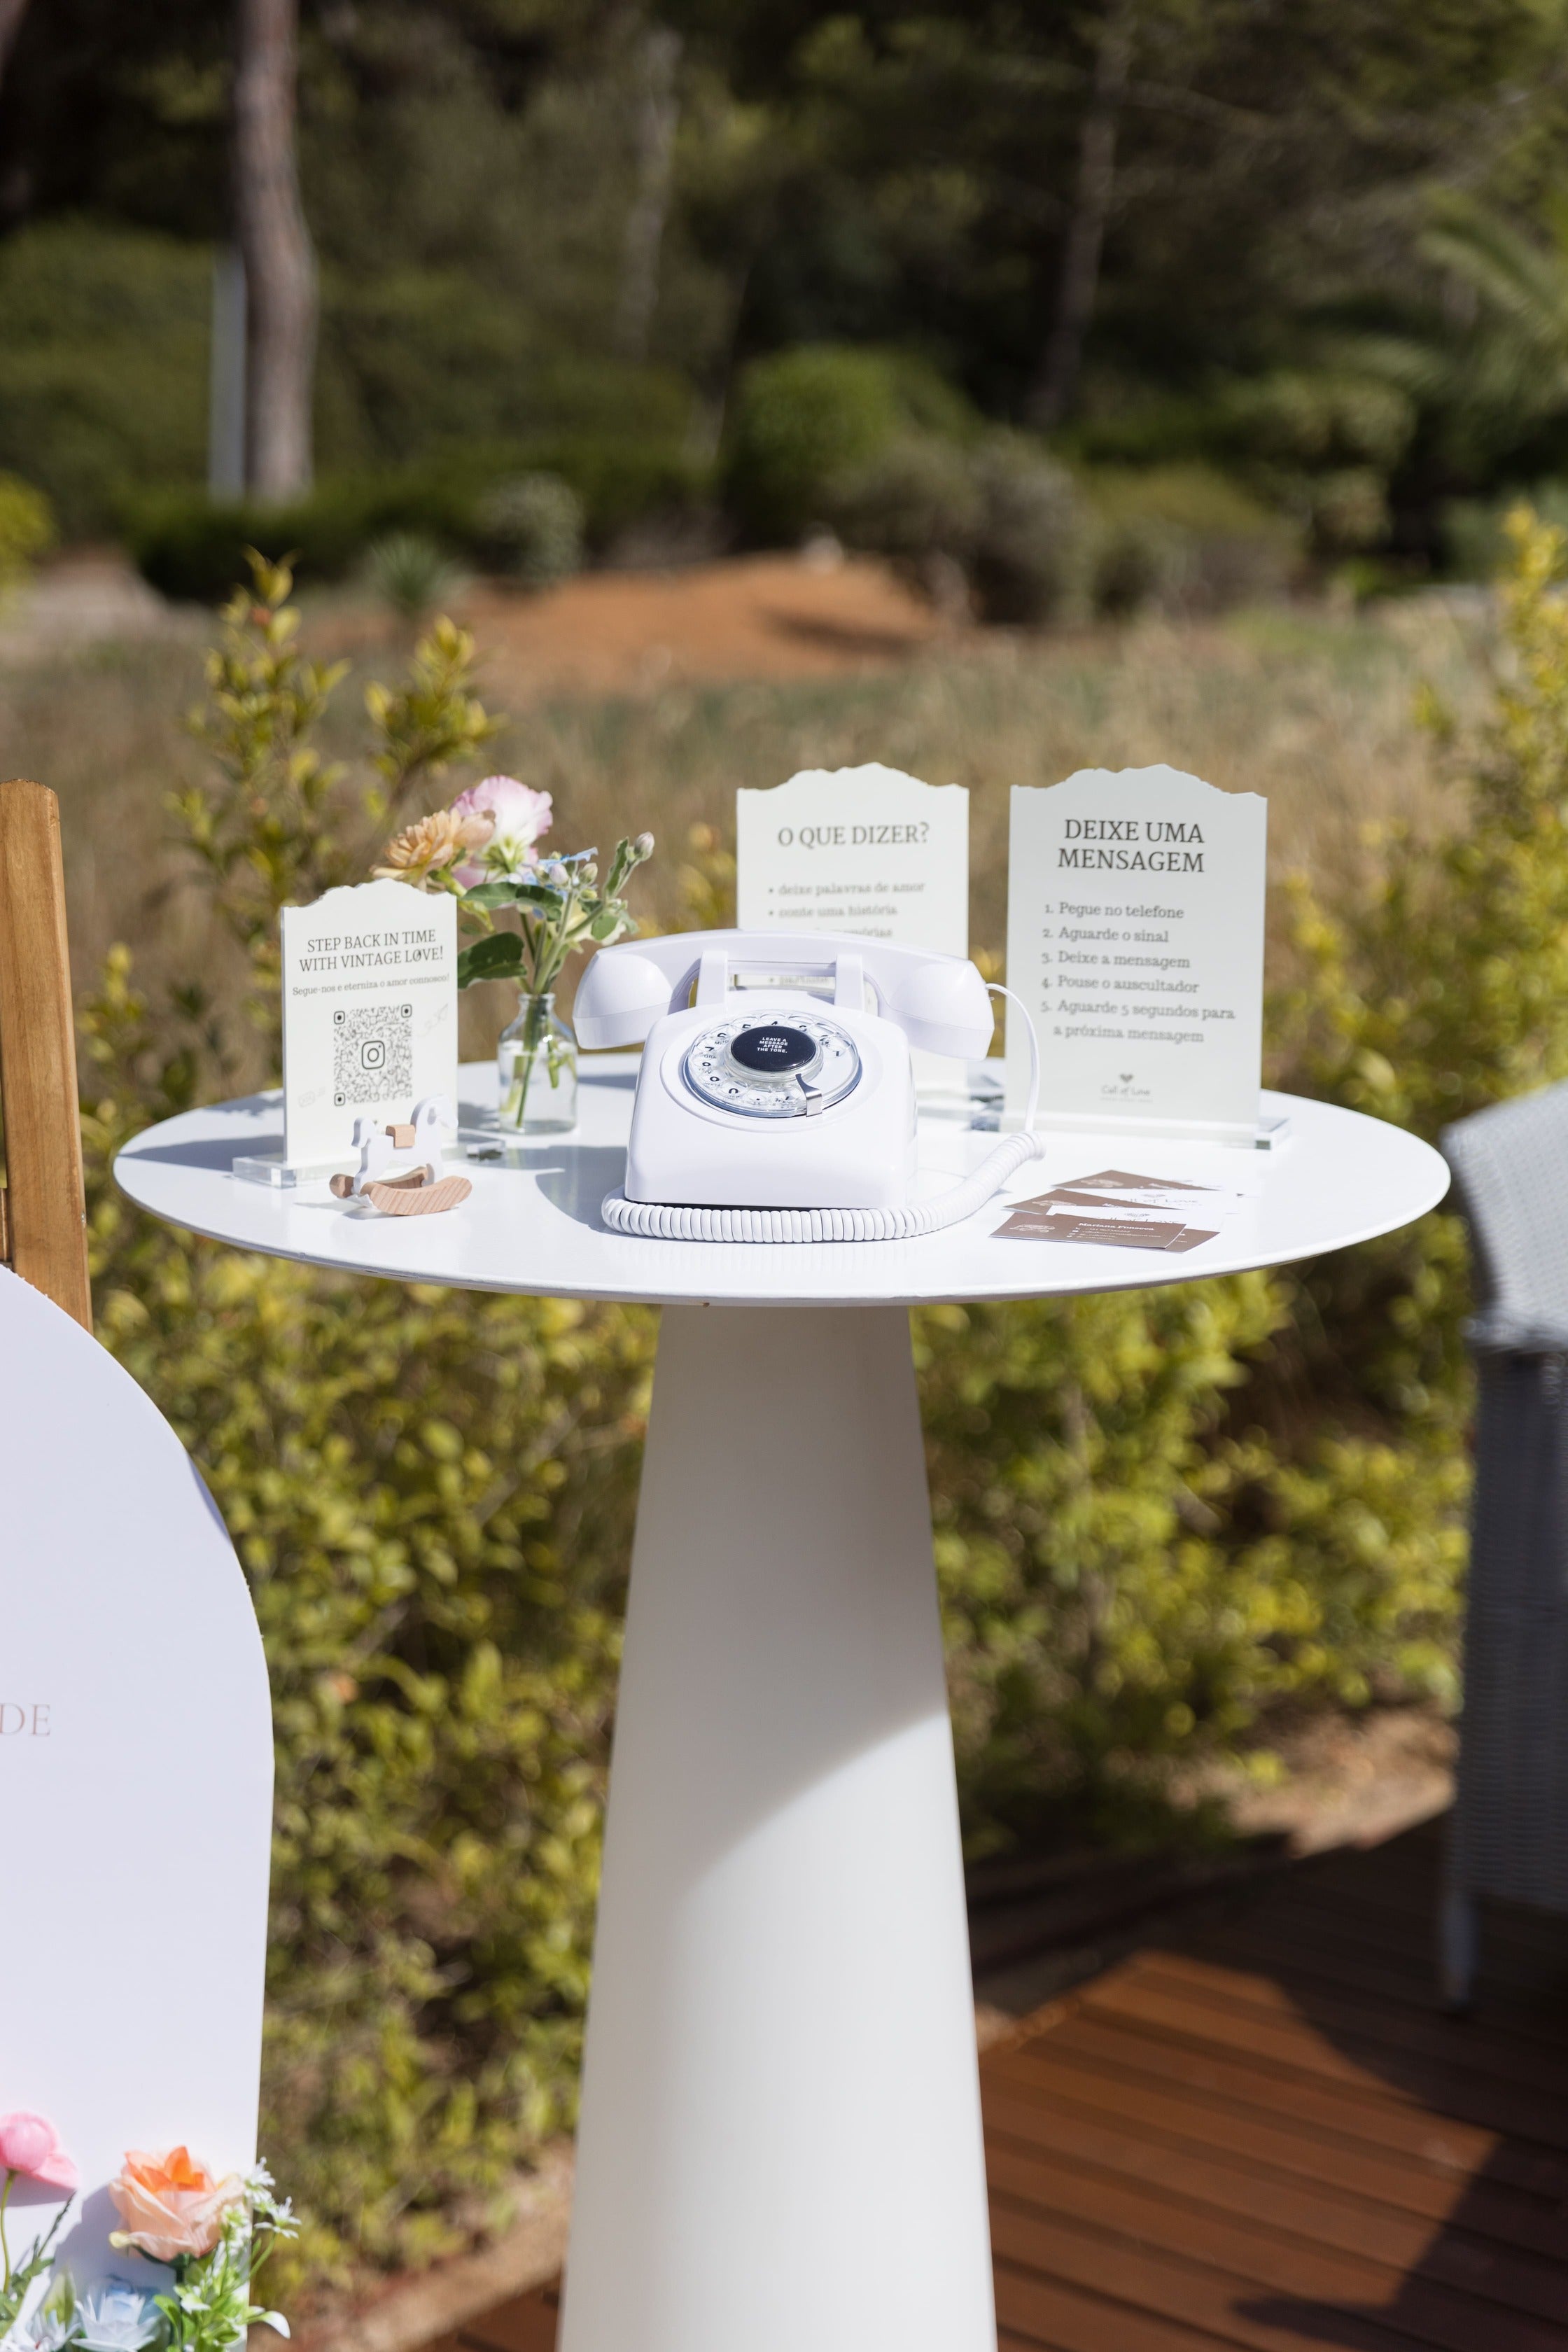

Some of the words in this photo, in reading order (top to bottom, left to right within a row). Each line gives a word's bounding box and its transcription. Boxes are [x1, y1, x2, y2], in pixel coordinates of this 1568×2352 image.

[778, 827, 793, 846] O
[799, 826, 846, 849] QUE
[852, 822, 930, 845] DIZER?
[1064, 819, 1140, 841] DEIXE
[1146, 822, 1205, 844] UMA
[1057, 848, 1205, 873] MENSAGEM
[1059, 901, 1101, 918] Pegue
[1105, 906, 1122, 916] no
[1126, 905, 1184, 919] telefone
[307, 937, 341, 952] STEP
[344, 933, 381, 949] BACK
[384, 932, 398, 946] IN
[402, 929, 436, 944] TIME
[1058, 926, 1119, 943] Aguarde
[1122, 931, 1130, 941] o
[1134, 930, 1168, 943] sinal
[299, 956, 337, 972] WITH
[341, 951, 401, 969] VINTAGE
[1058, 950, 1098, 965] Deixe
[1102, 956, 1110, 965] a
[1114, 955, 1190, 969] mensagem
[293, 982, 336, 997] Segue-nos
[344, 979, 378, 990] eterniza
[409, 974, 450, 986] connosco!
[1058, 974, 1099, 989] Pouse
[1102, 981, 1110, 989] o
[1114, 978, 1199, 993] auscultador
[1058, 999, 1118, 1015] Aguarde
[1121, 1004, 1129, 1016] 5
[1133, 1003, 1198, 1018] segundos
[1202, 1008, 1236, 1021] para
[1053, 1026, 1062, 1035] a
[1065, 1023, 1124, 1039] próxima
[1128, 1026, 1204, 1044] mensagem
